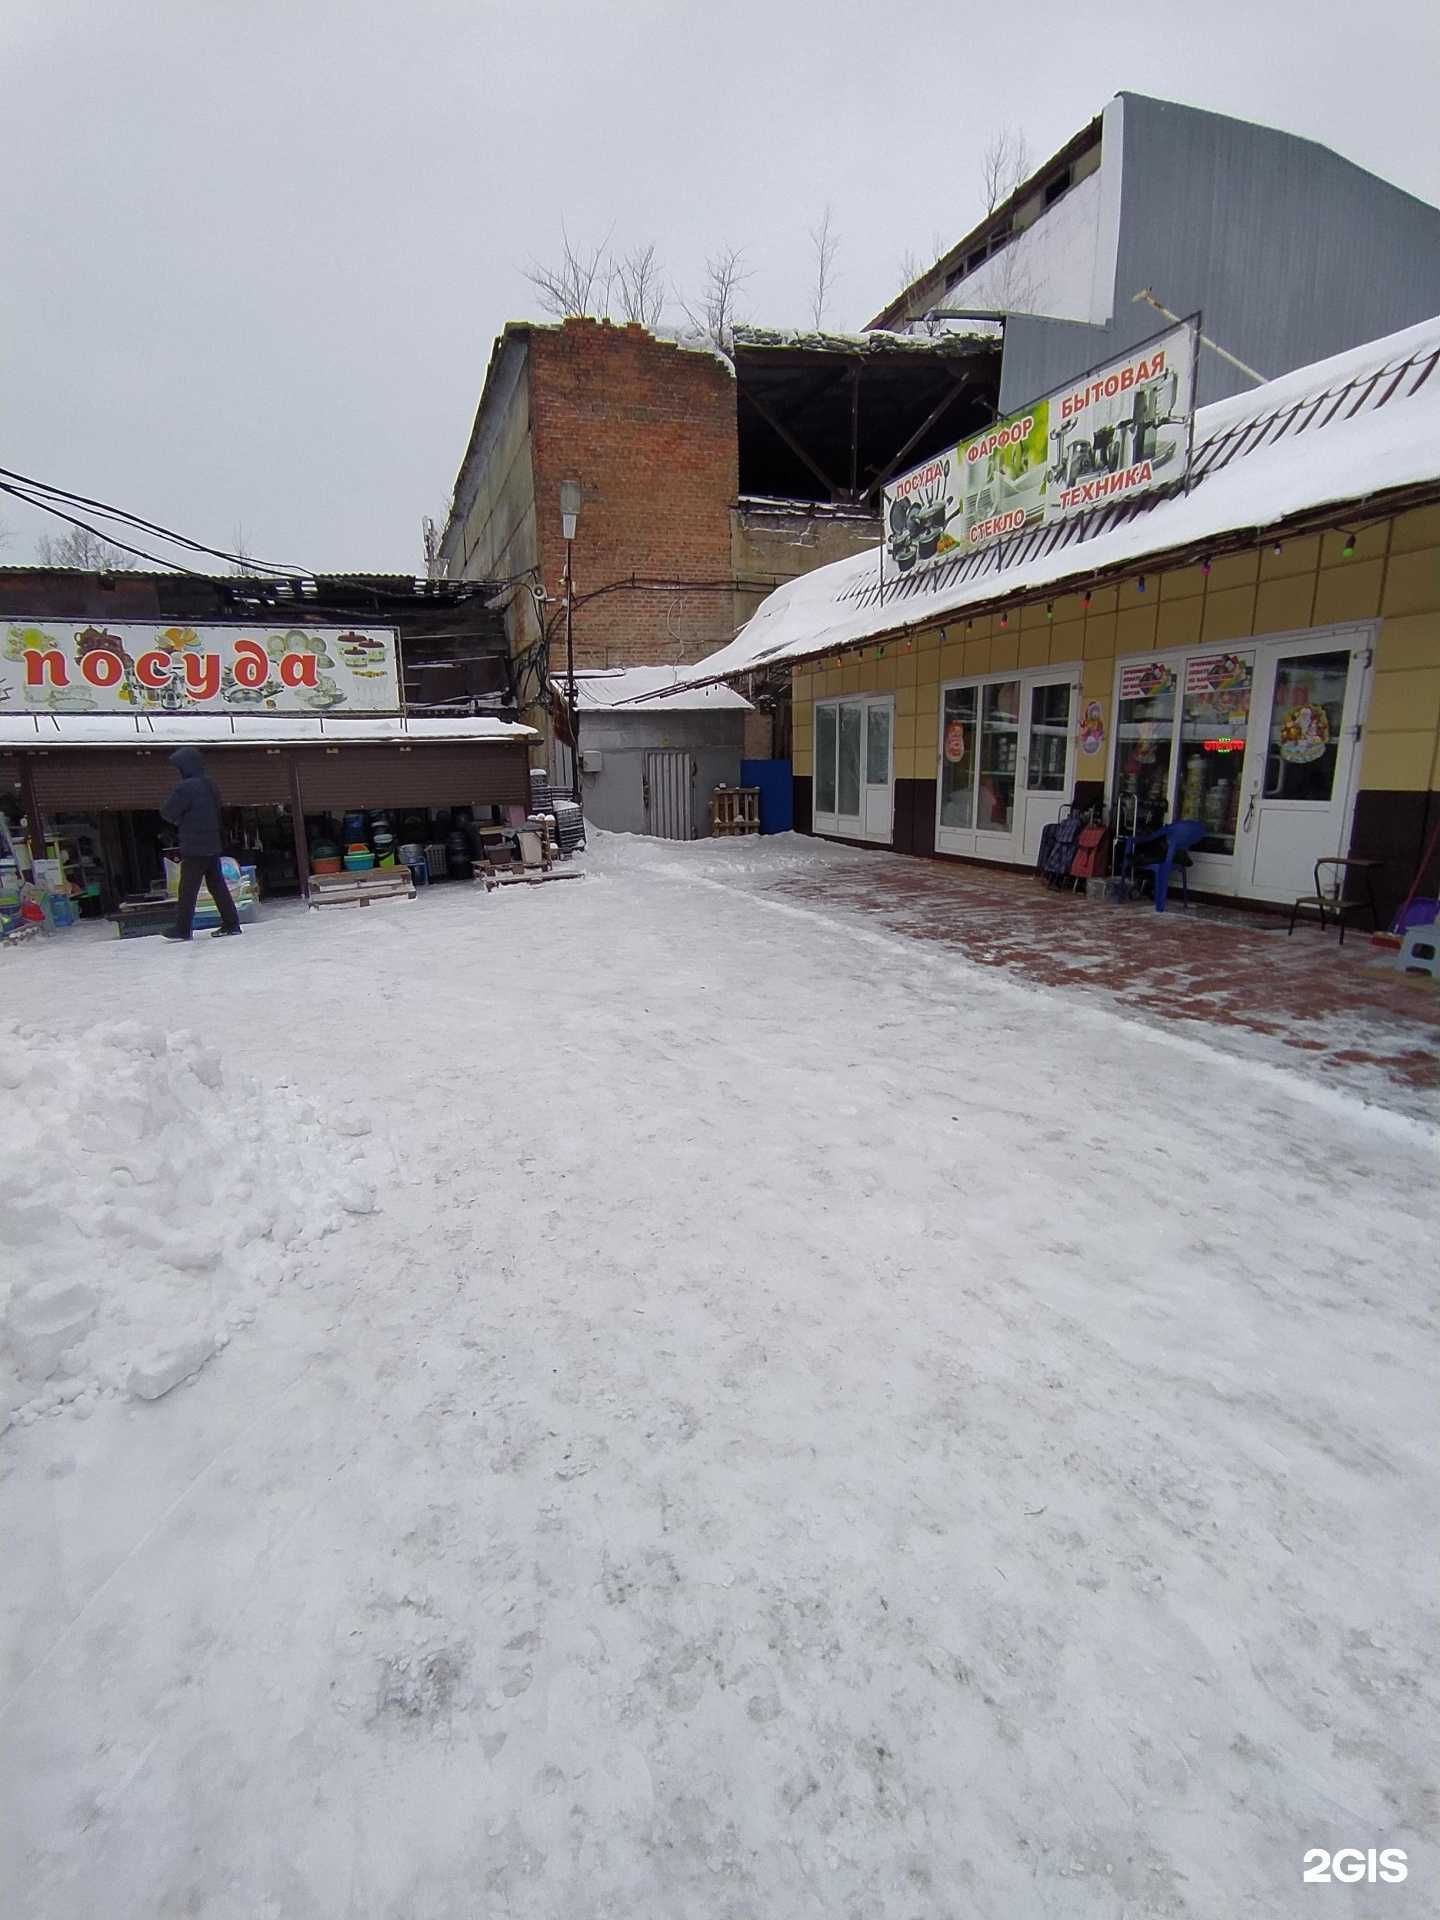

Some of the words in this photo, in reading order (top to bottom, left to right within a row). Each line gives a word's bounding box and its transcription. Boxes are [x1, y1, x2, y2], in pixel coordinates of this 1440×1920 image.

[1061, 351, 1166, 419] БЫТОВАЯ
[966, 416, 1033, 463] ФАРФОР
[896, 463, 944, 497] ПОСУДА
[1059, 461, 1153, 510] ТЕХНИКА
[969, 509, 1025, 543] СТЕКЛО
[23, 638, 320, 700] посуда
